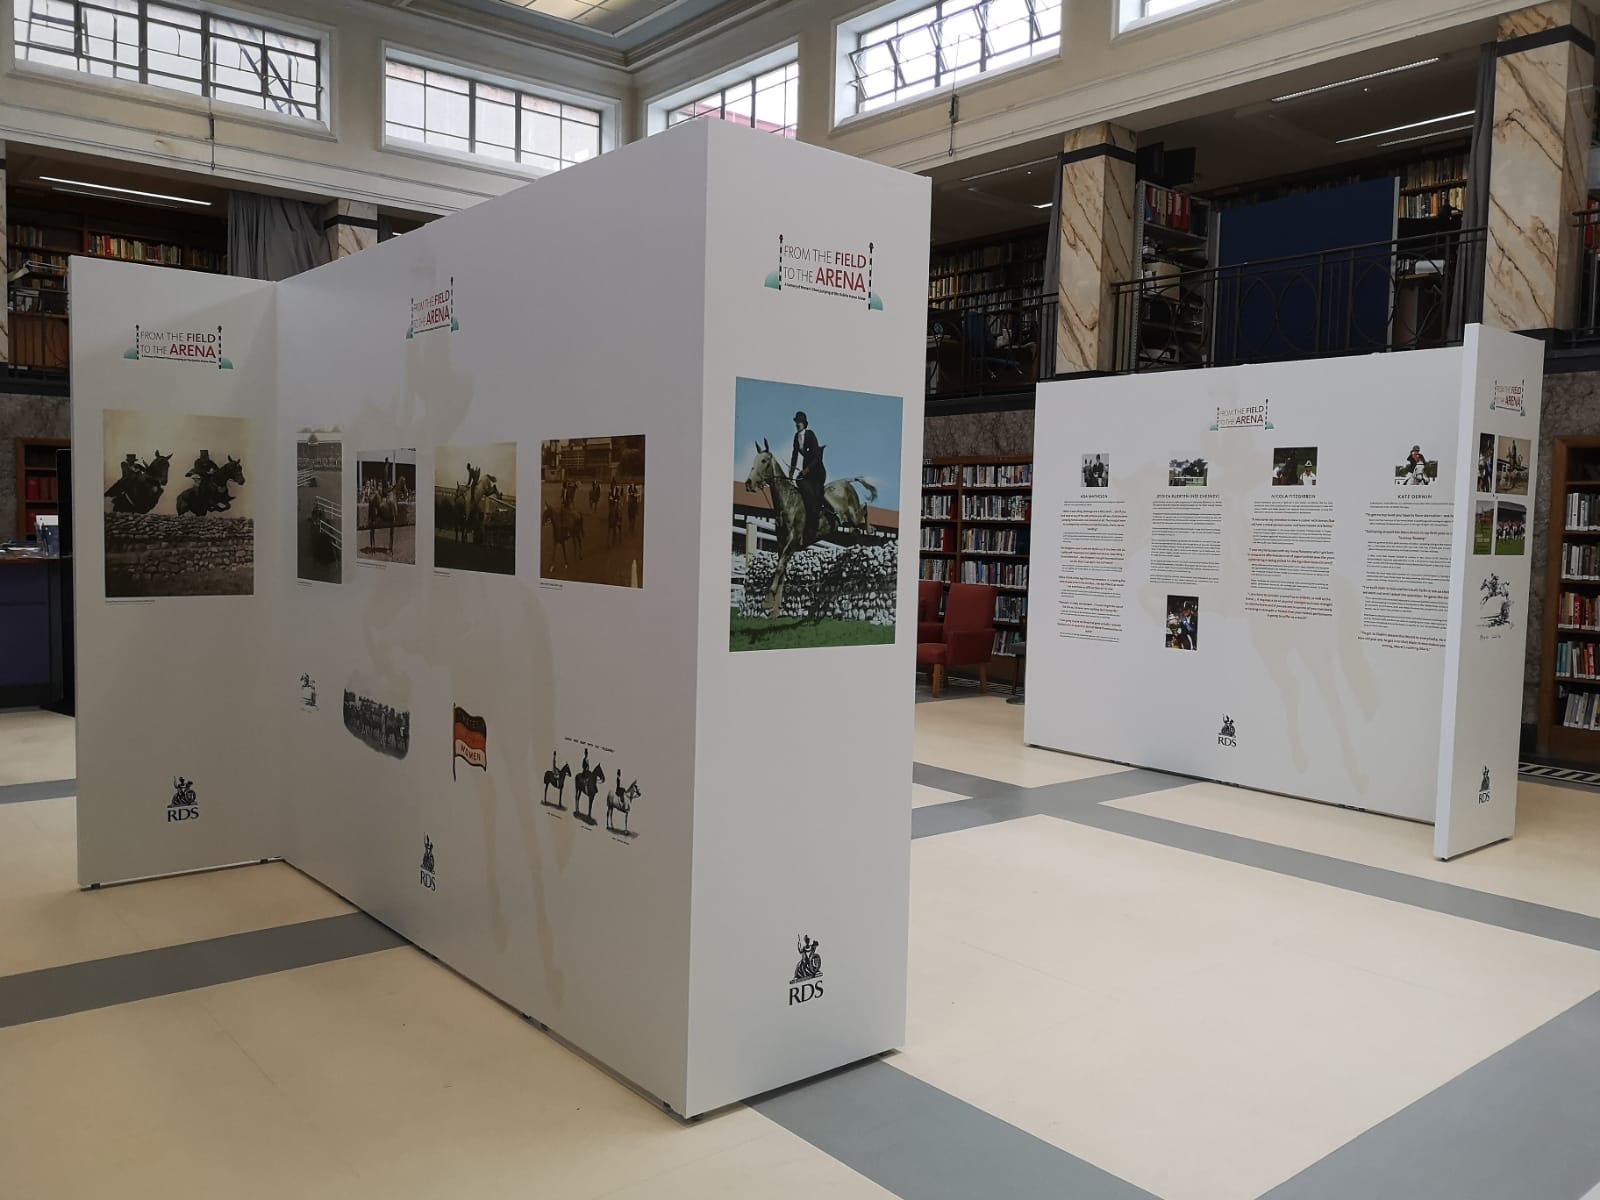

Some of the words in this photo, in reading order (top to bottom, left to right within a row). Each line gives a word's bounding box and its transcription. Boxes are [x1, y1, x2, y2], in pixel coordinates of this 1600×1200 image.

[784, 245, 811, 261] FROM
[812, 248, 832, 264] THE
[835, 251, 867, 269] FIELD
[783, 266, 796, 280] TO
[797, 268, 814, 284] THE
[815, 266, 866, 293] ARENA
[434, 289, 450, 306] FIELD
[426, 305, 450, 325] ARENA
[140, 331, 164, 341] FROM
[166, 332, 184, 342] THE
[186, 332, 216, 343] FIELD
[141, 344, 151, 353] TO
[153, 345, 168, 355] THE
[169, 343, 217, 358] ARENA
[1246, 405, 1264, 414] FIELD
[1236, 414, 1264, 425] ARENA
[1218, 736, 1237, 748] RDS
[460, 744, 481, 761] WOMEN
[167, 807, 200, 823] RDS
[420, 870, 436, 892] RDS
[789, 980, 824, 1006] RDS
